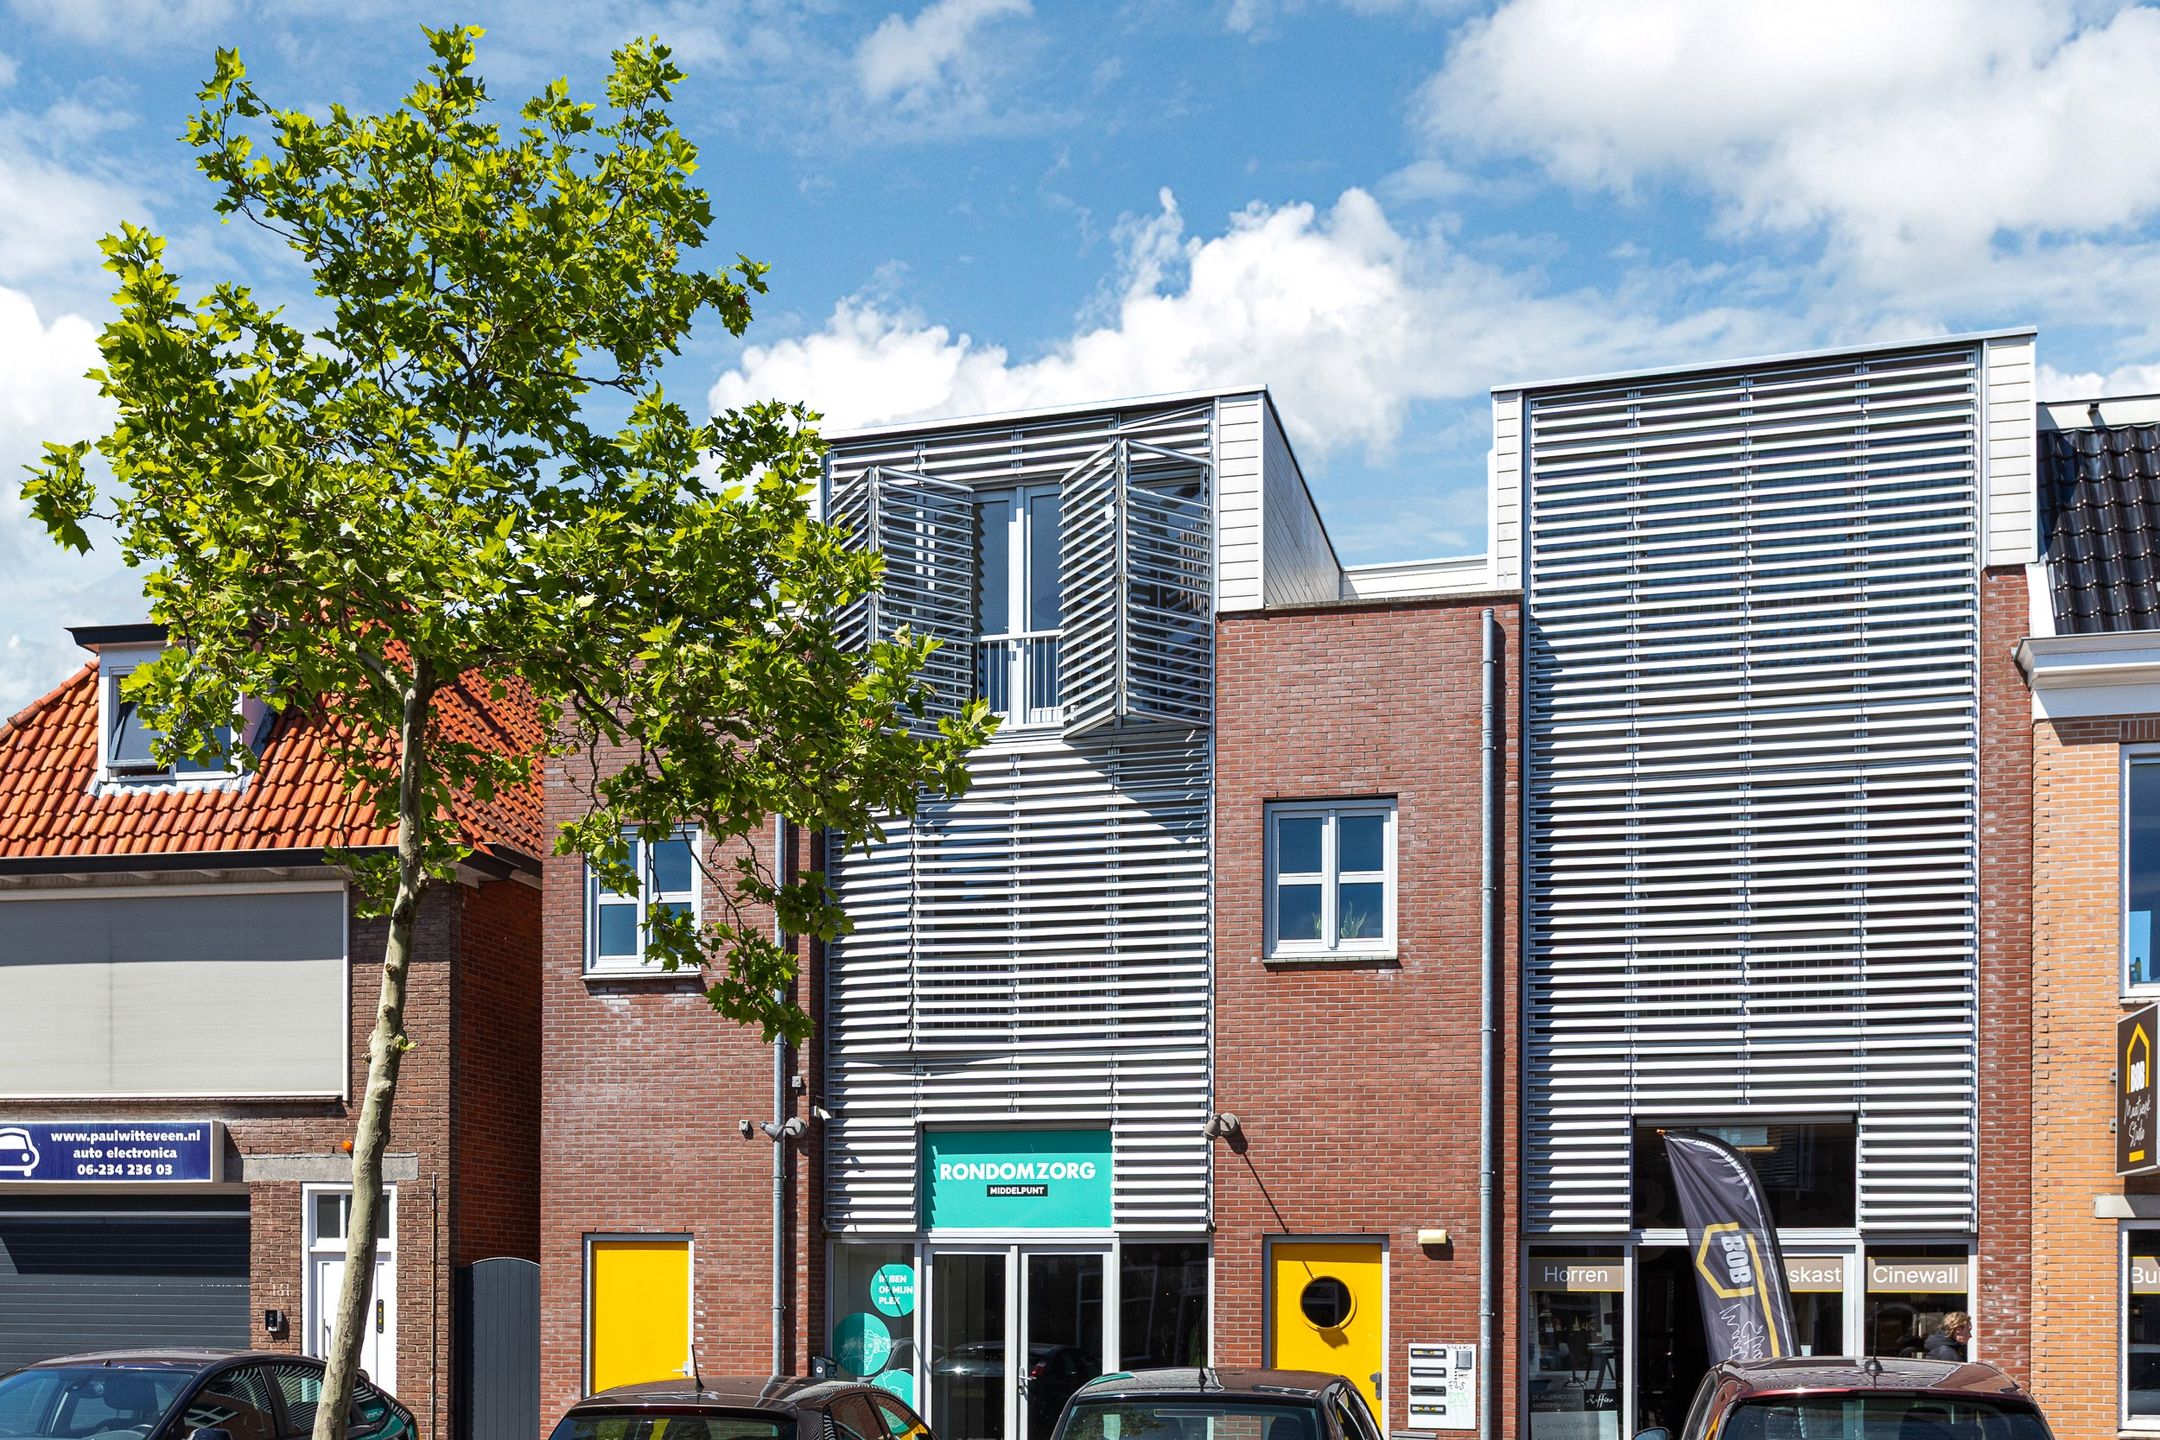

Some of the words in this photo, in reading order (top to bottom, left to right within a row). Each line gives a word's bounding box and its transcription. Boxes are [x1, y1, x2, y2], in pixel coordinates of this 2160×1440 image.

[2130, 1061, 2145, 1093] BOB
[51, 1130, 201, 1144] www.paulwitteveen.nl
[73, 1147, 103, 1159] auto
[106, 1147, 178, 1159] electronica
[77, 1164, 123, 1175] 06-234
[127, 1164, 152, 1175] 236
[156, 1164, 173, 1175] 03
[940, 1162, 1096, 1180] RONDOMZORG
[990, 1187, 1045, 1195] MIDDELPUNT
[888, 1275, 907, 1283] BEN
[1544, 1266, 1608, 1282] Horren
[1780, 1266, 1842, 1282] skast
[1872, 1266, 1959, 1283] Cinewall
